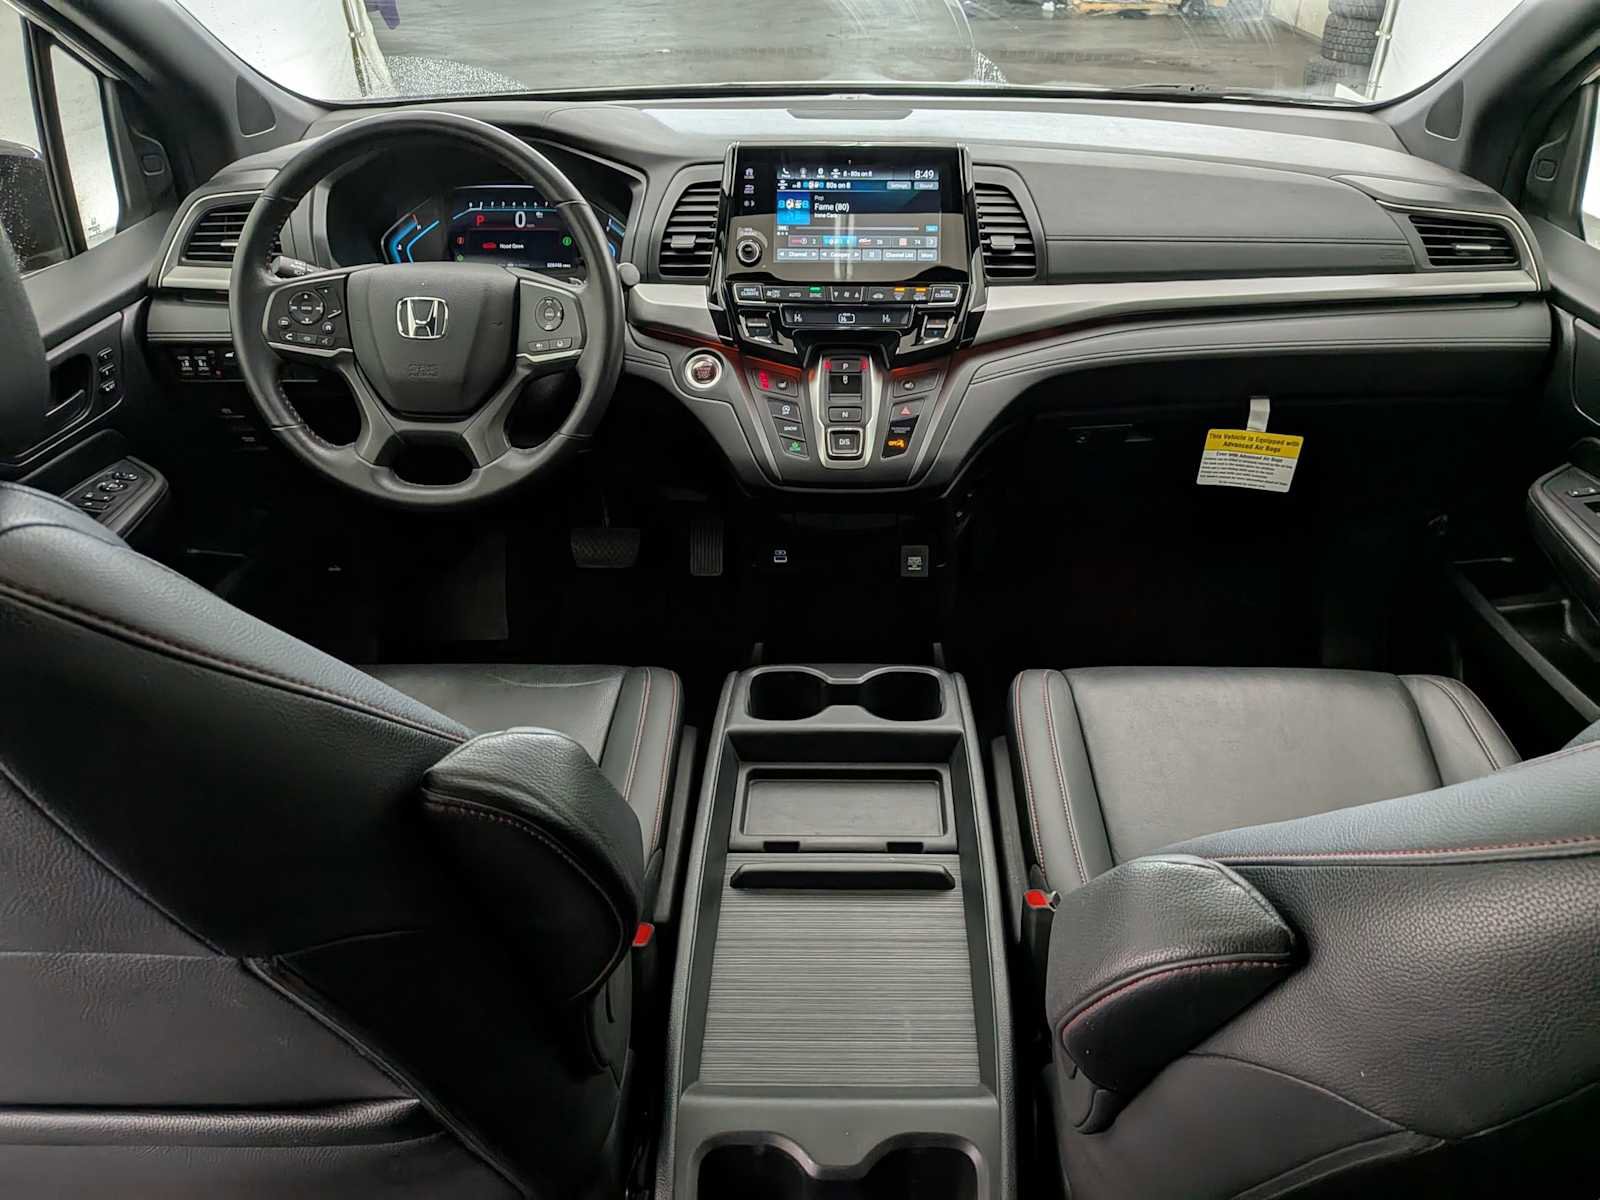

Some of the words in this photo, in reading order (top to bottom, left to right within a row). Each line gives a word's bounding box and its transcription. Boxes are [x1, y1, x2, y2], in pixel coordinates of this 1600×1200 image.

[914, 170, 934, 179] 8:49
[476, 215, 486, 225] P
[515, 211, 526, 228] 0
[1255, 436, 1284, 445] Equipped
